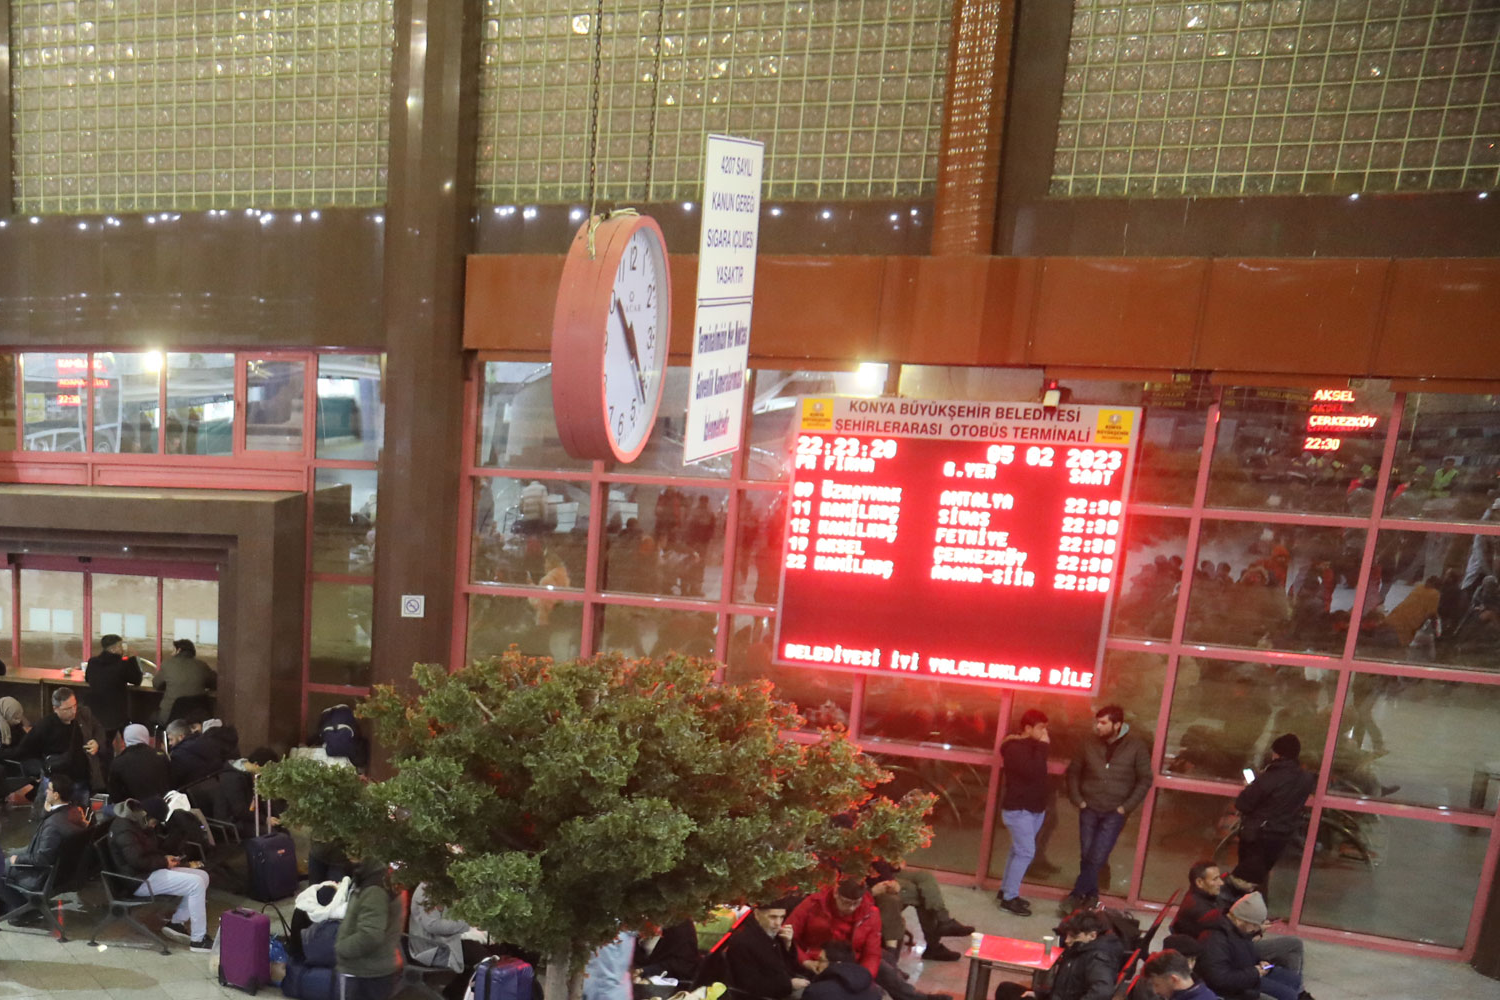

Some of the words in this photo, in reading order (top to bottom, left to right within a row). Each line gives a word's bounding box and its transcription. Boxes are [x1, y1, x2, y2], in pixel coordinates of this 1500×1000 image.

[1314, 390, 1355, 402] AKSEL
[850, 400, 895, 415] KONYA
[900, 400, 991, 421] BÜYÜKŞEHİR
[1309, 415, 1377, 427] ÇERKEZKÖY
[835, 417, 942, 435] ŞEHİRLERARASI
[950, 422, 1008, 439] OTOBÜS
[1013, 425, 1091, 443] TERMİNALİ
[1304, 437, 1340, 450] 22:30
[987, 445, 1015, 464] 05
[1026, 446, 1054, 467] 02
[1065, 448, 1122, 471] 2023
